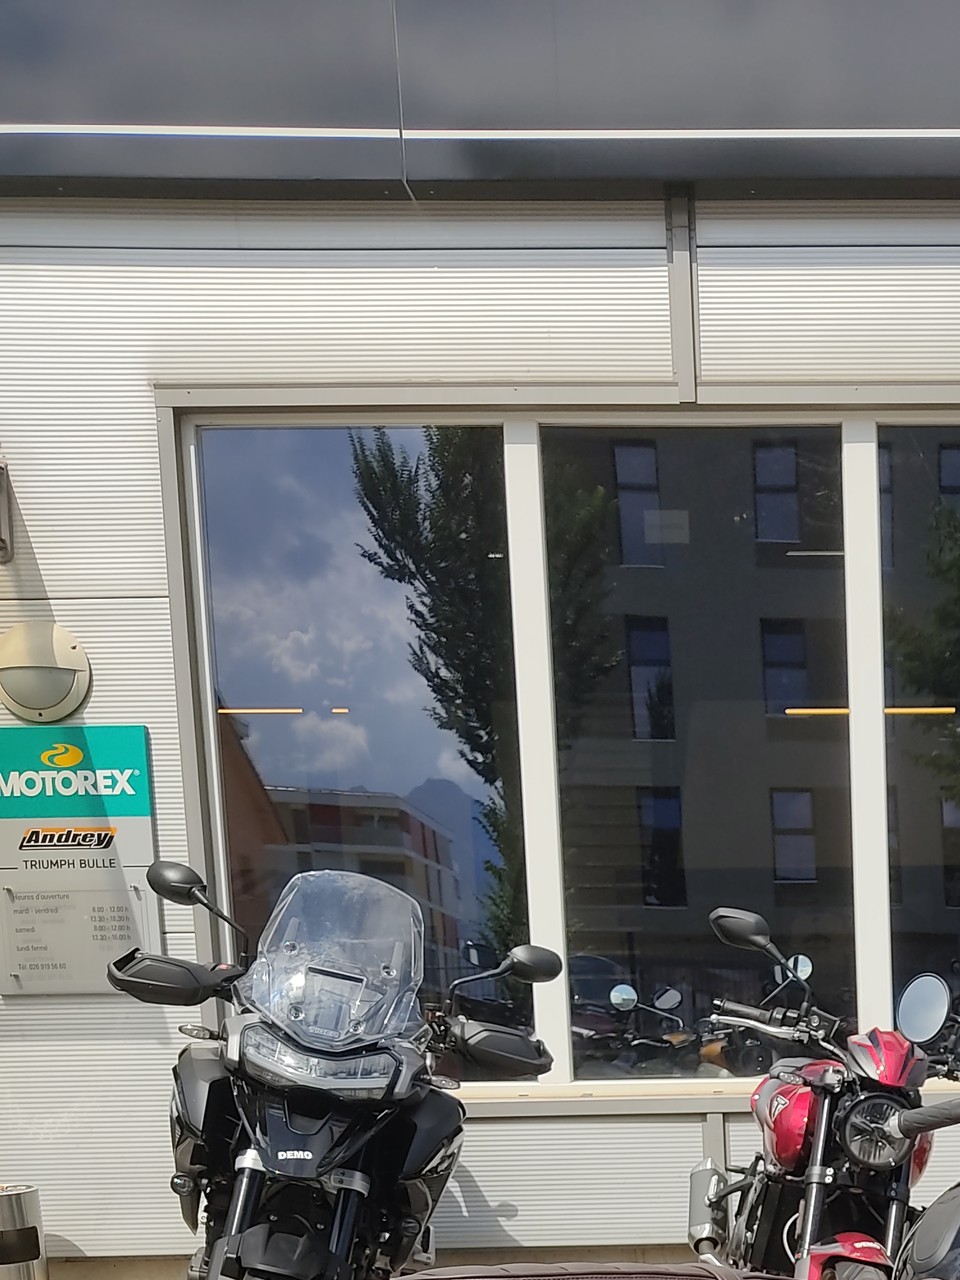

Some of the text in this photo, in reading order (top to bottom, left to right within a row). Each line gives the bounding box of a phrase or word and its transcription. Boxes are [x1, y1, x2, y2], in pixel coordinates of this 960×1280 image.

[0, 769, 136, 797] MOTOREX
[24, 828, 111, 849] Andrey
[23, 858, 117, 870] TRIUMPH BULLE
[277, 1151, 312, 1160] DEMO
